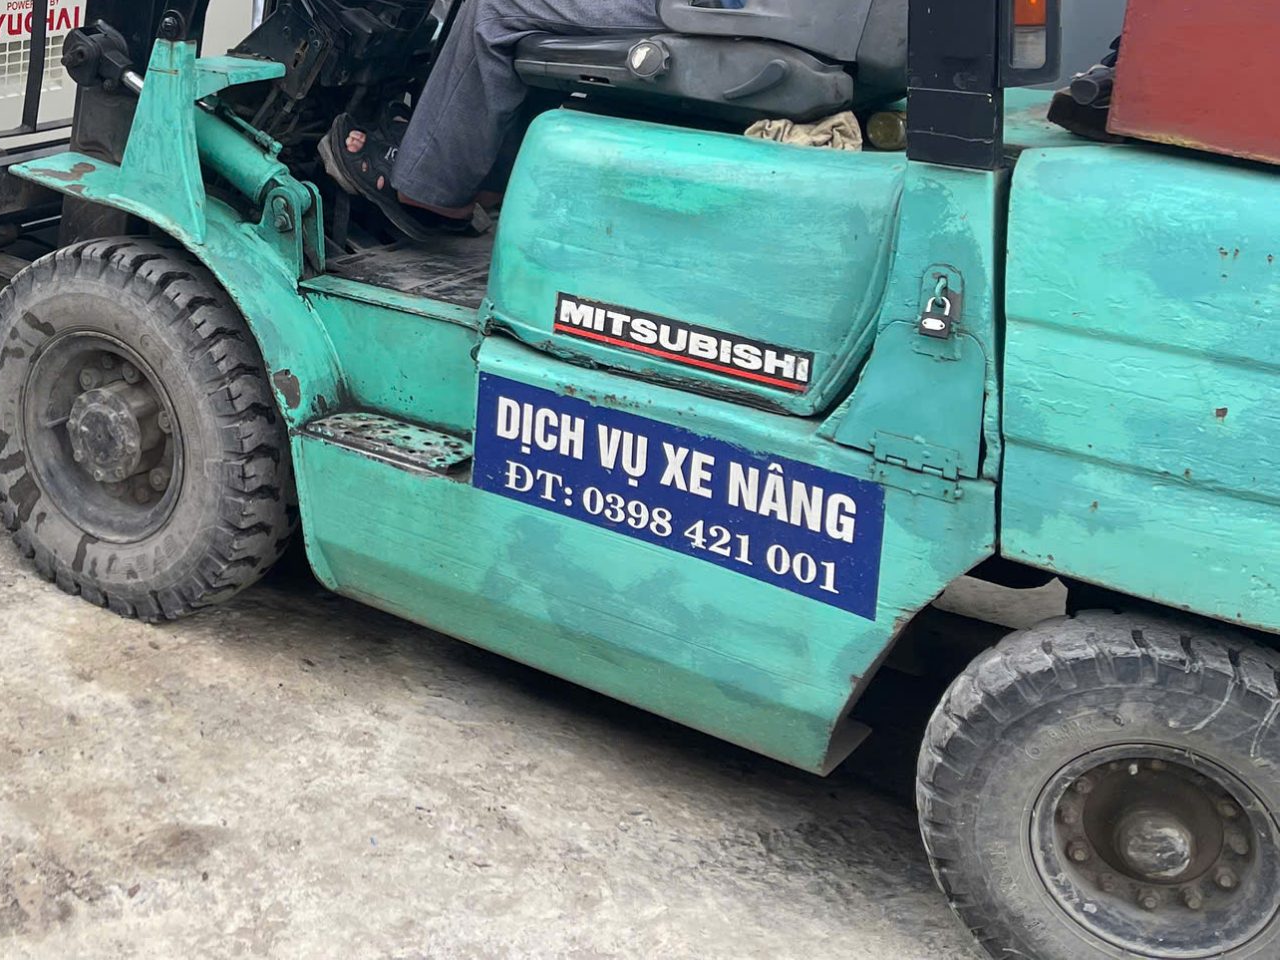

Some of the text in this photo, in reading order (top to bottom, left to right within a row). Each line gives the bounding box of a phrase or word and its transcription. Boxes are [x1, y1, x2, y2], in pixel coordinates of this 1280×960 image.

[559, 299, 810, 382] MITSUBISHI
[496, 396, 857, 544] DỊCH VỤ XE NÂNG
[505, 459, 840, 594] ĐT: 0398 421 001
